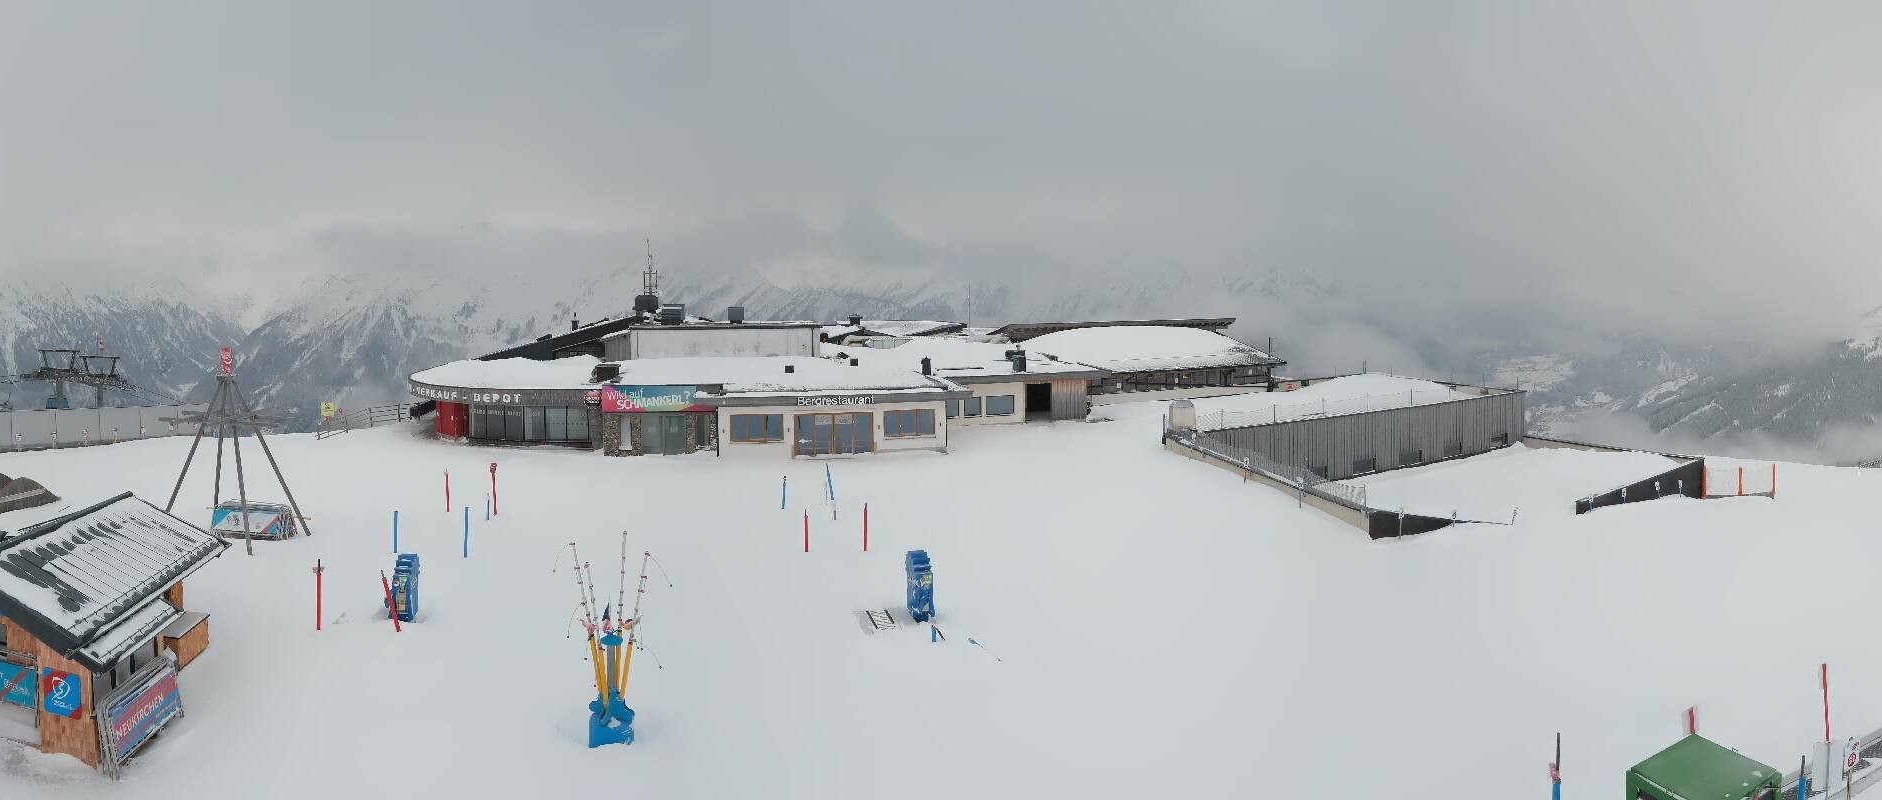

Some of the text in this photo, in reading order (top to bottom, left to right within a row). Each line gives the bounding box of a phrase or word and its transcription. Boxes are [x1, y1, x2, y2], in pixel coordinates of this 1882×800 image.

[416, 387, 457, 400] VERKAUF
[474, 393, 522, 403] DEPOT
[607, 388, 643, 400] Wild auf
[616, 391, 691, 410] SCHMANKERL?
[797, 395, 875, 407] Bergrestaurant
[114, 692, 165, 740] NEUKIRCHEN
